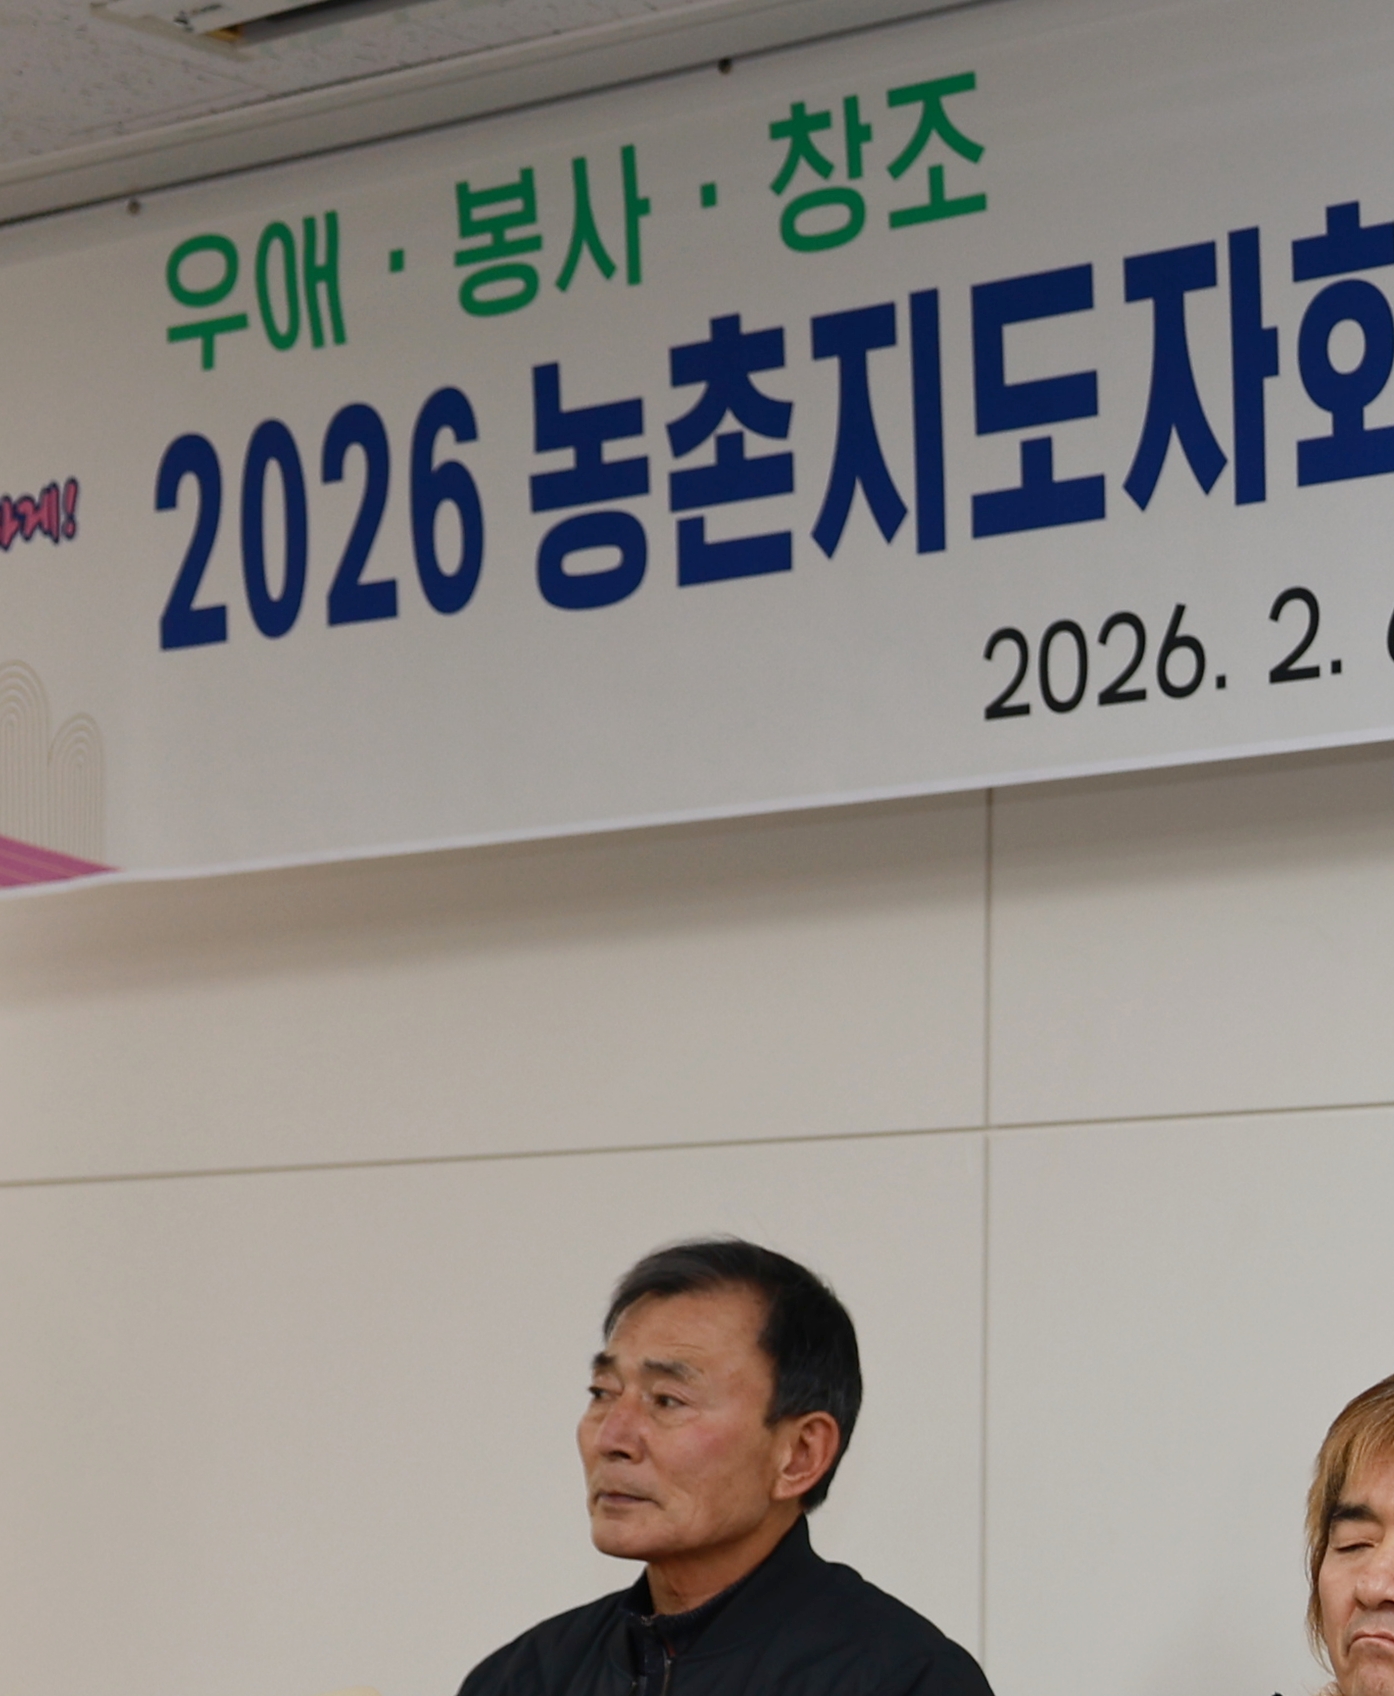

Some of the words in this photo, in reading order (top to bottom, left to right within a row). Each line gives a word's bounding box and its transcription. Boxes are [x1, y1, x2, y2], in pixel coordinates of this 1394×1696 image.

[167, 211, 347, 371] 우애
[454, 145, 652, 318] 봉사
[769, 71, 988, 253] 창조
[154, 386, 484, 650] 2026
[984, 603, 1227, 721] 2026.
[1269, 586, 1343, 684] 2.
